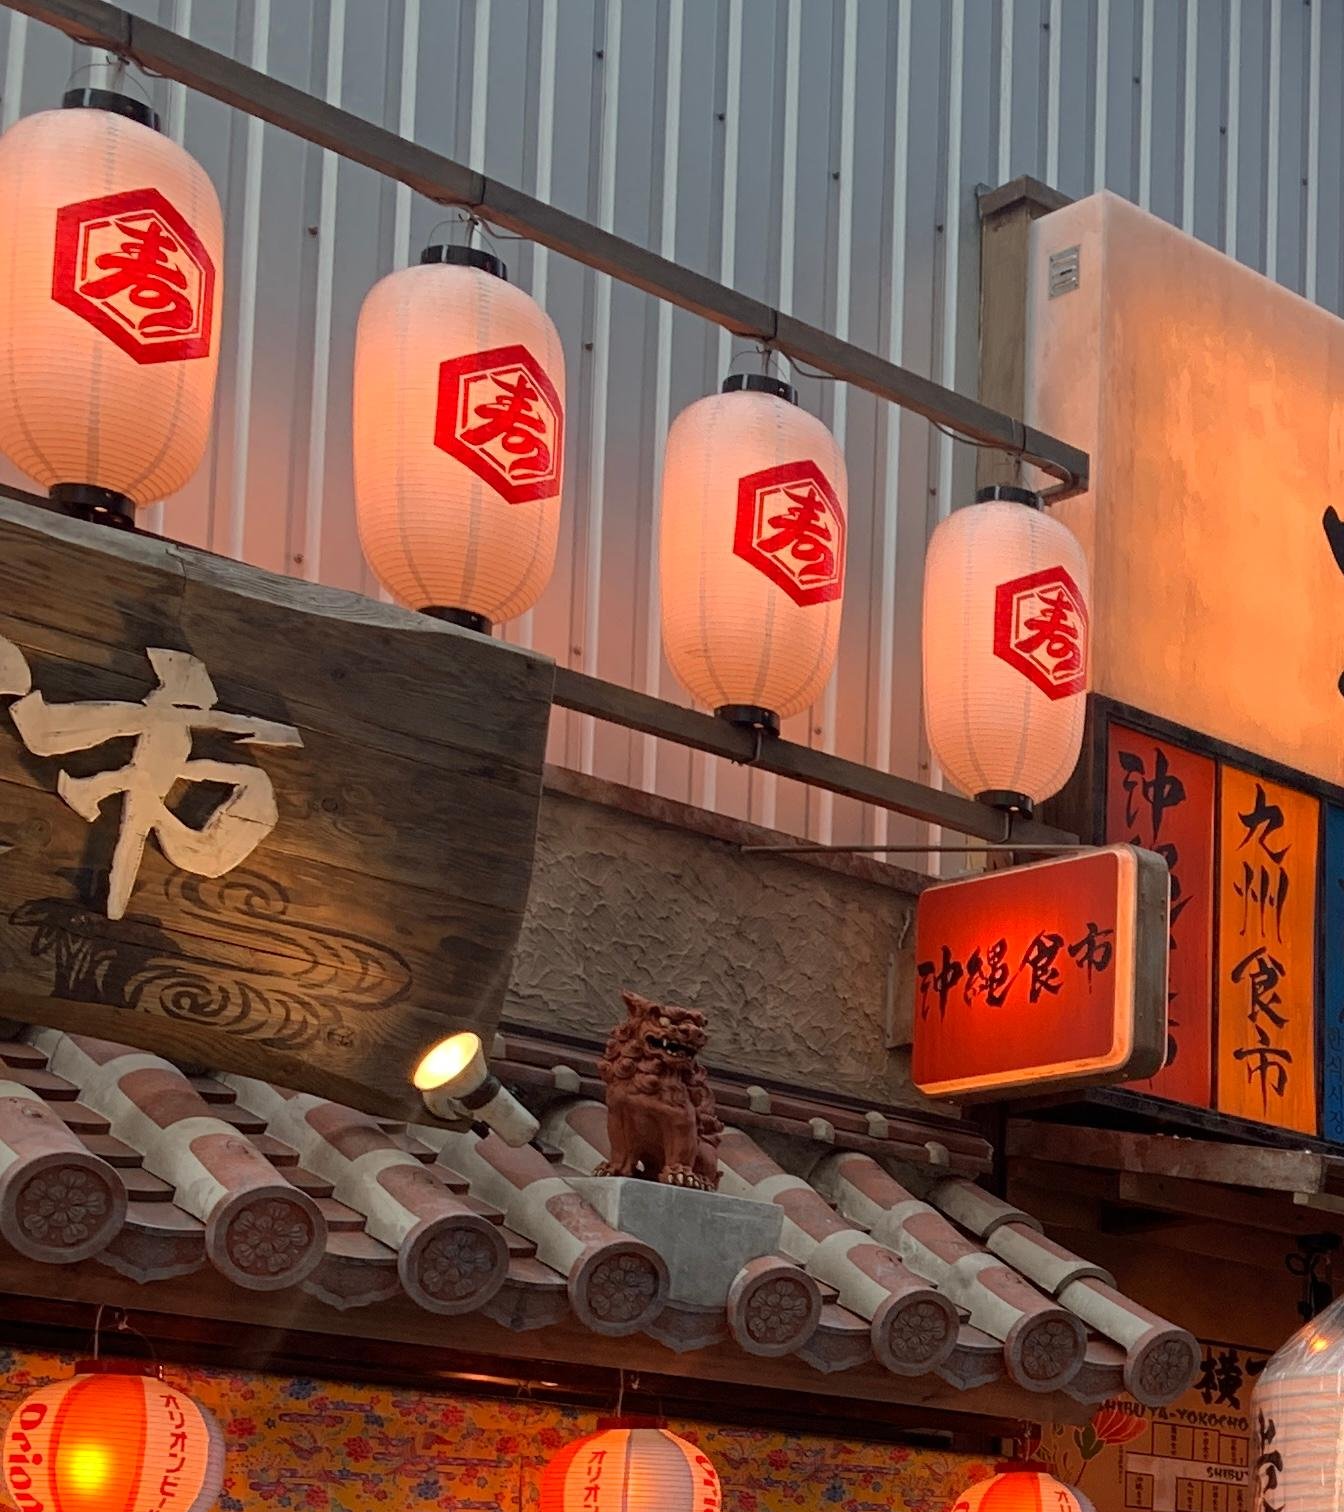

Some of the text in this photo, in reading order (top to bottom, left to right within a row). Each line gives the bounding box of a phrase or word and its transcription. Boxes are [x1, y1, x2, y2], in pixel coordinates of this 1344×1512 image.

[916, 922, 1115, 1023] 沖縄食市
[1231, 783, 1292, 1116] 九州食市
